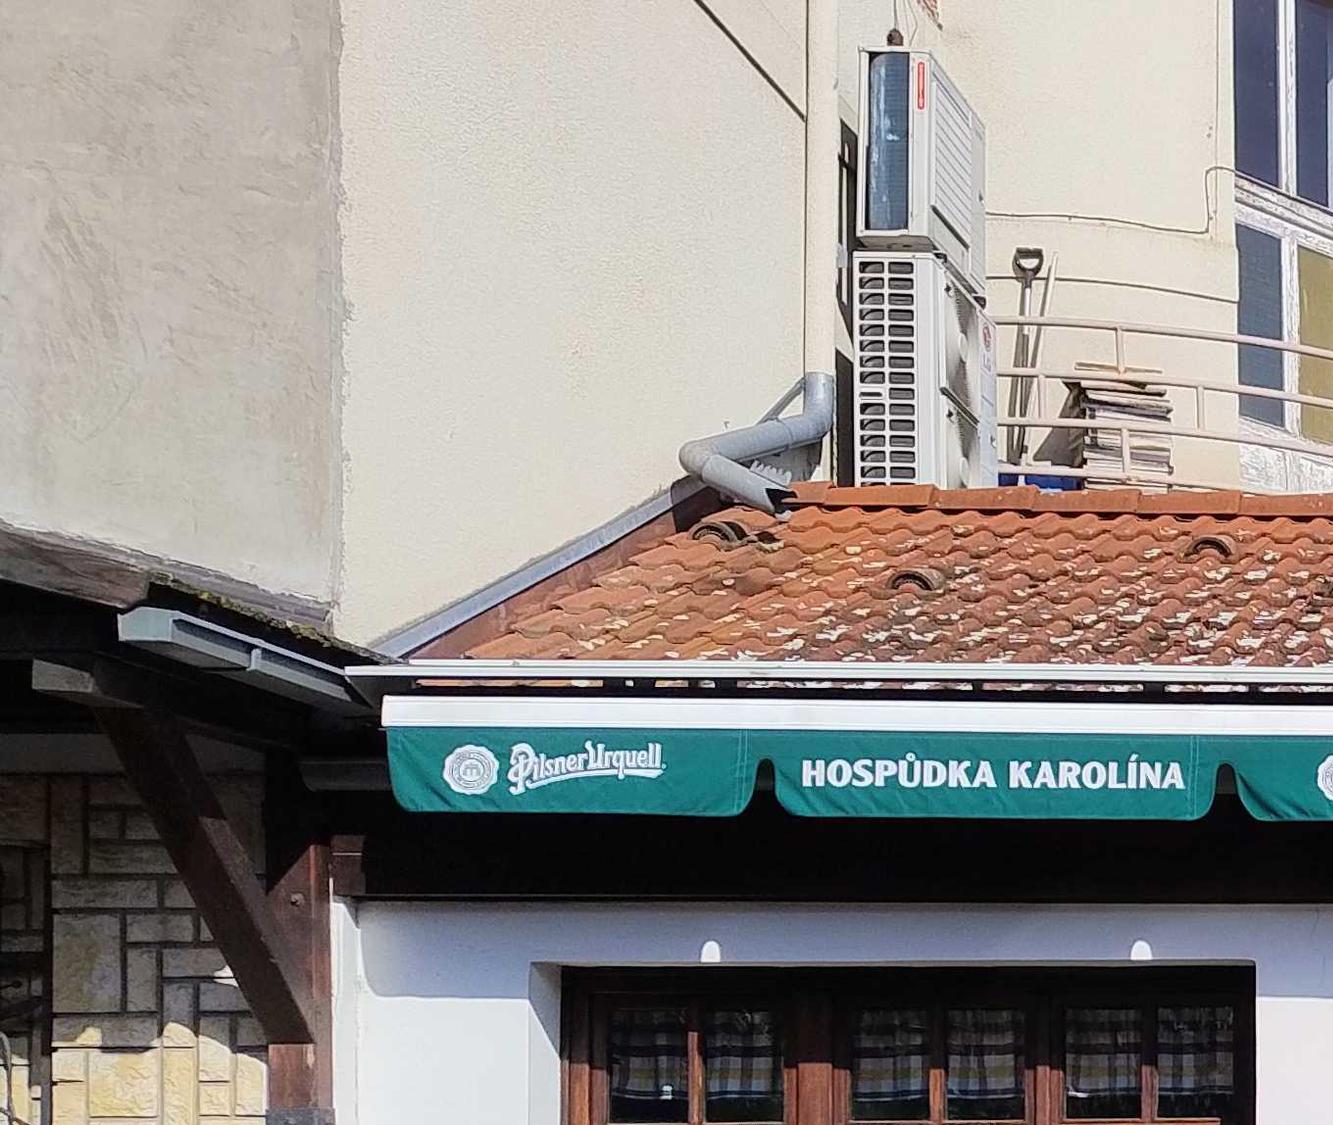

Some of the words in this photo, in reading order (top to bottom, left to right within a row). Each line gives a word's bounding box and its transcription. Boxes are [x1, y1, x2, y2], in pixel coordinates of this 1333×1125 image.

[507, 742, 588, 796] Pilsner
[585, 740, 662, 780] Urquell
[802, 752, 997, 788] HOSPŮDKA
[1009, 754, 1186, 789] KAROLÍNA
